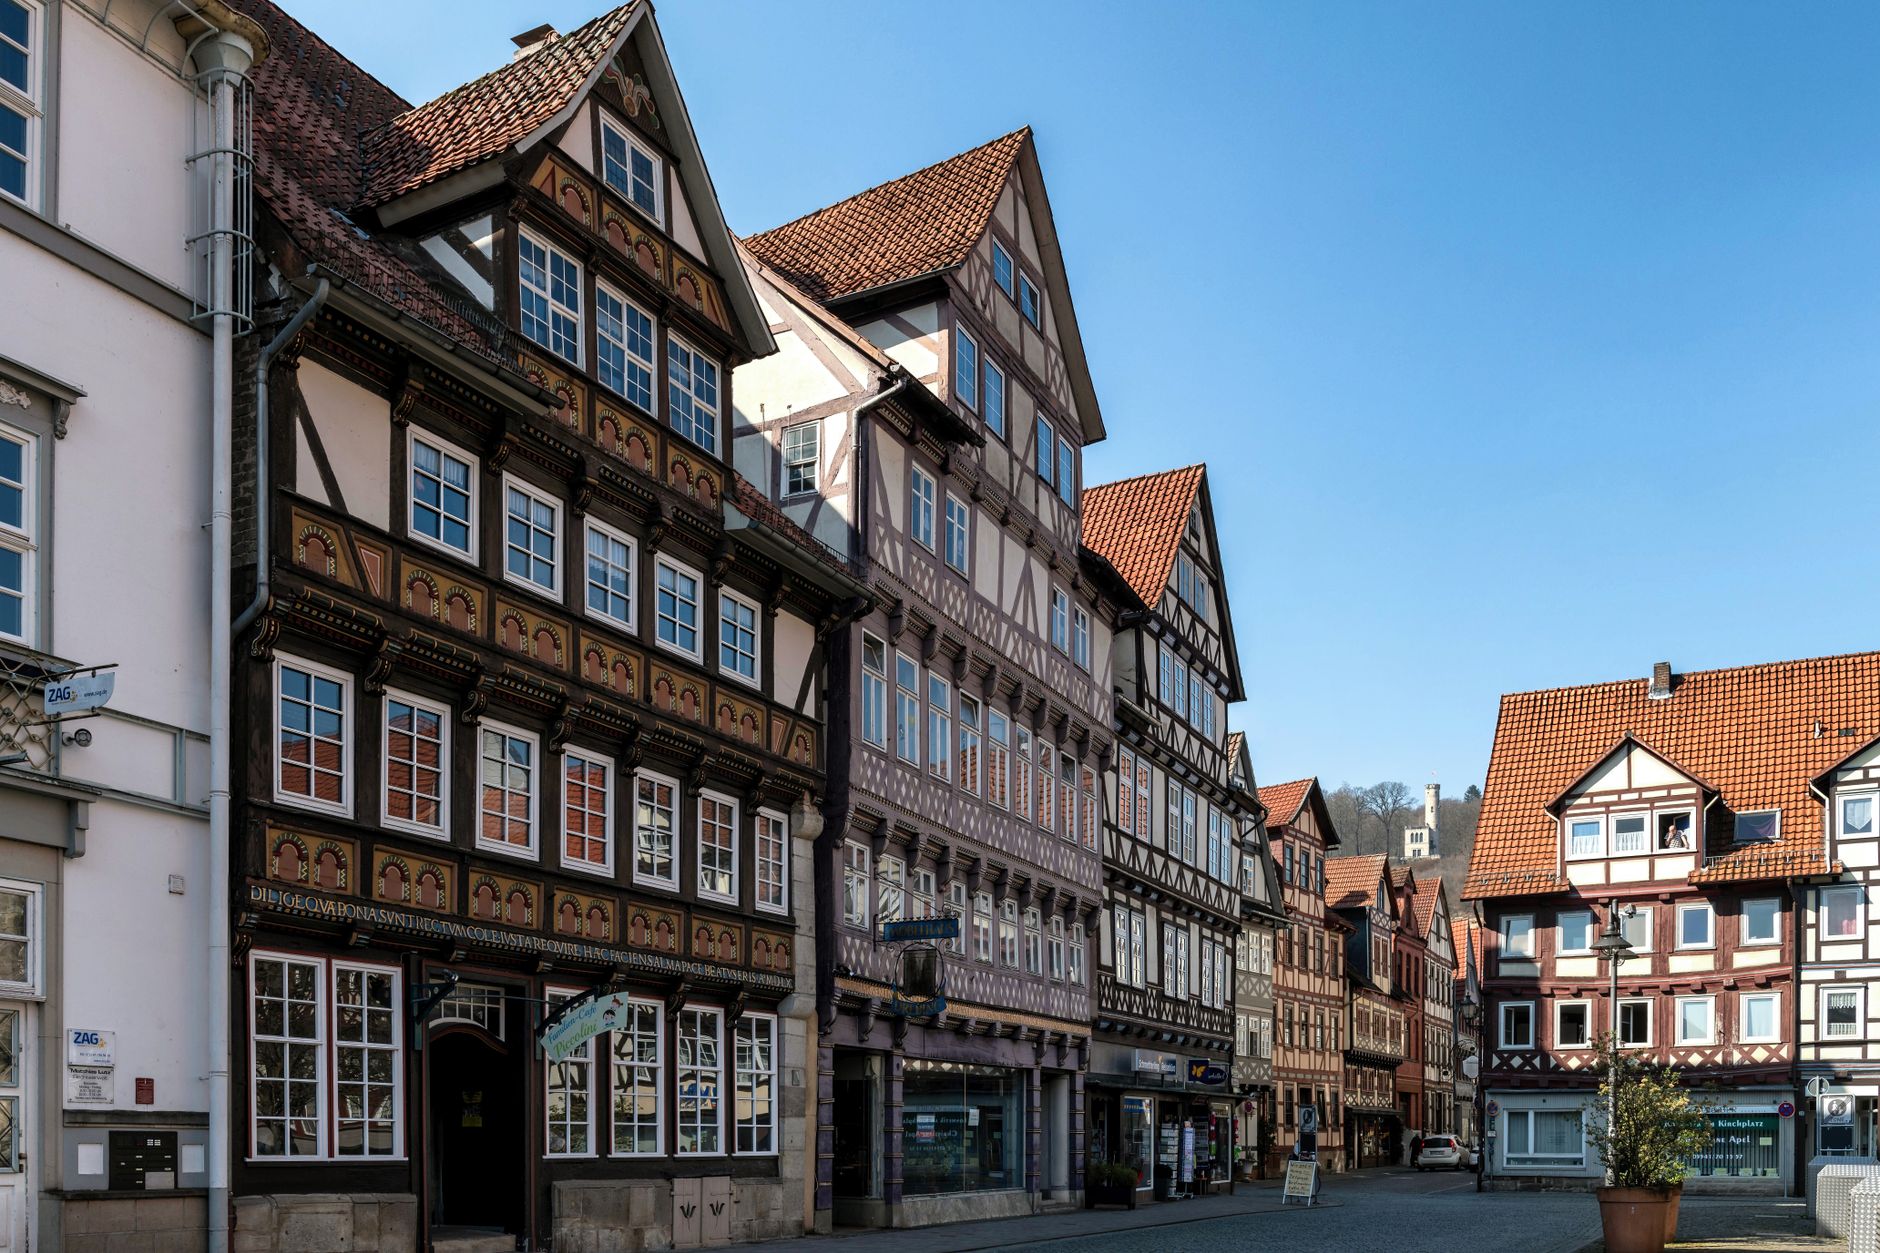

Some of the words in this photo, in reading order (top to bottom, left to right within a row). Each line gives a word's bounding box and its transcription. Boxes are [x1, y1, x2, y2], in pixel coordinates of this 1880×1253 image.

[48, 686, 71, 702] ZAG
[73, 1032, 99, 1045] ZAG
[1718, 1119, 1763, 1128] Kirchplatz
[1729, 1135, 1751, 1144] Apel
